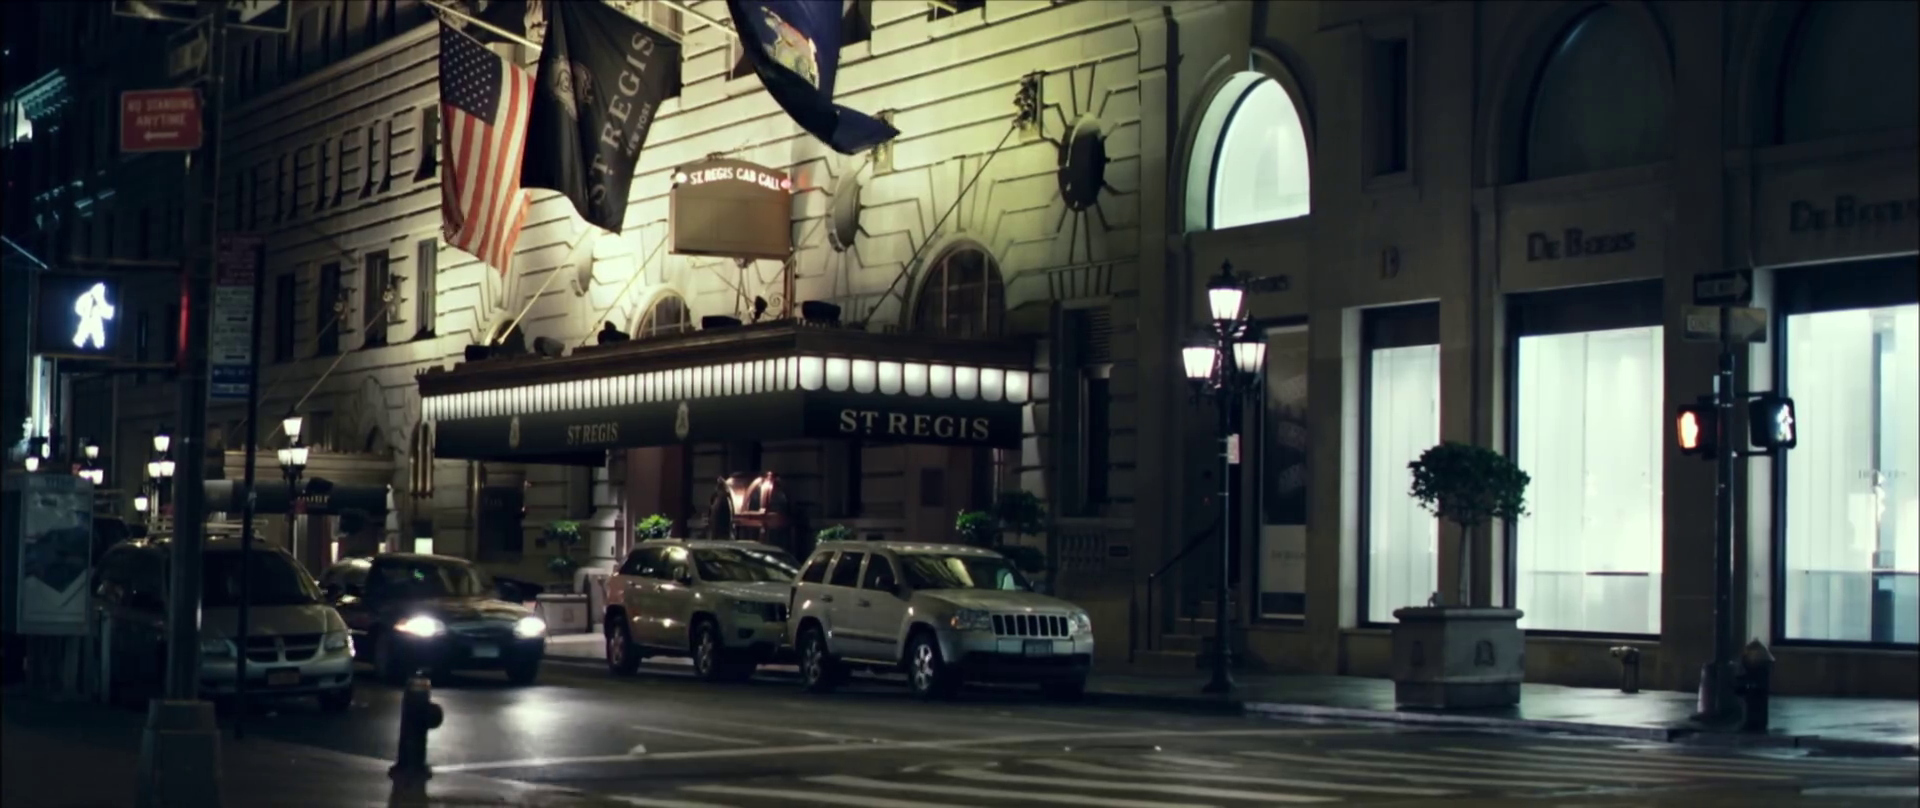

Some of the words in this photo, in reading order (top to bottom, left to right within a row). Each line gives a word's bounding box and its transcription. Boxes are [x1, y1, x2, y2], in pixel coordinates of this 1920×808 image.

[601, 31, 655, 150] REGIS
[127, 99, 142, 113] NO
[145, 97, 196, 112] STANDING
[135, 112, 187, 128] ANYTIME
[704, 166, 734, 183] REGIS
[736, 167, 757, 184] CAB
[758, 173, 781, 191] CALL
[582, 421, 620, 445] REGIS
[887, 411, 990, 441] REGIS
